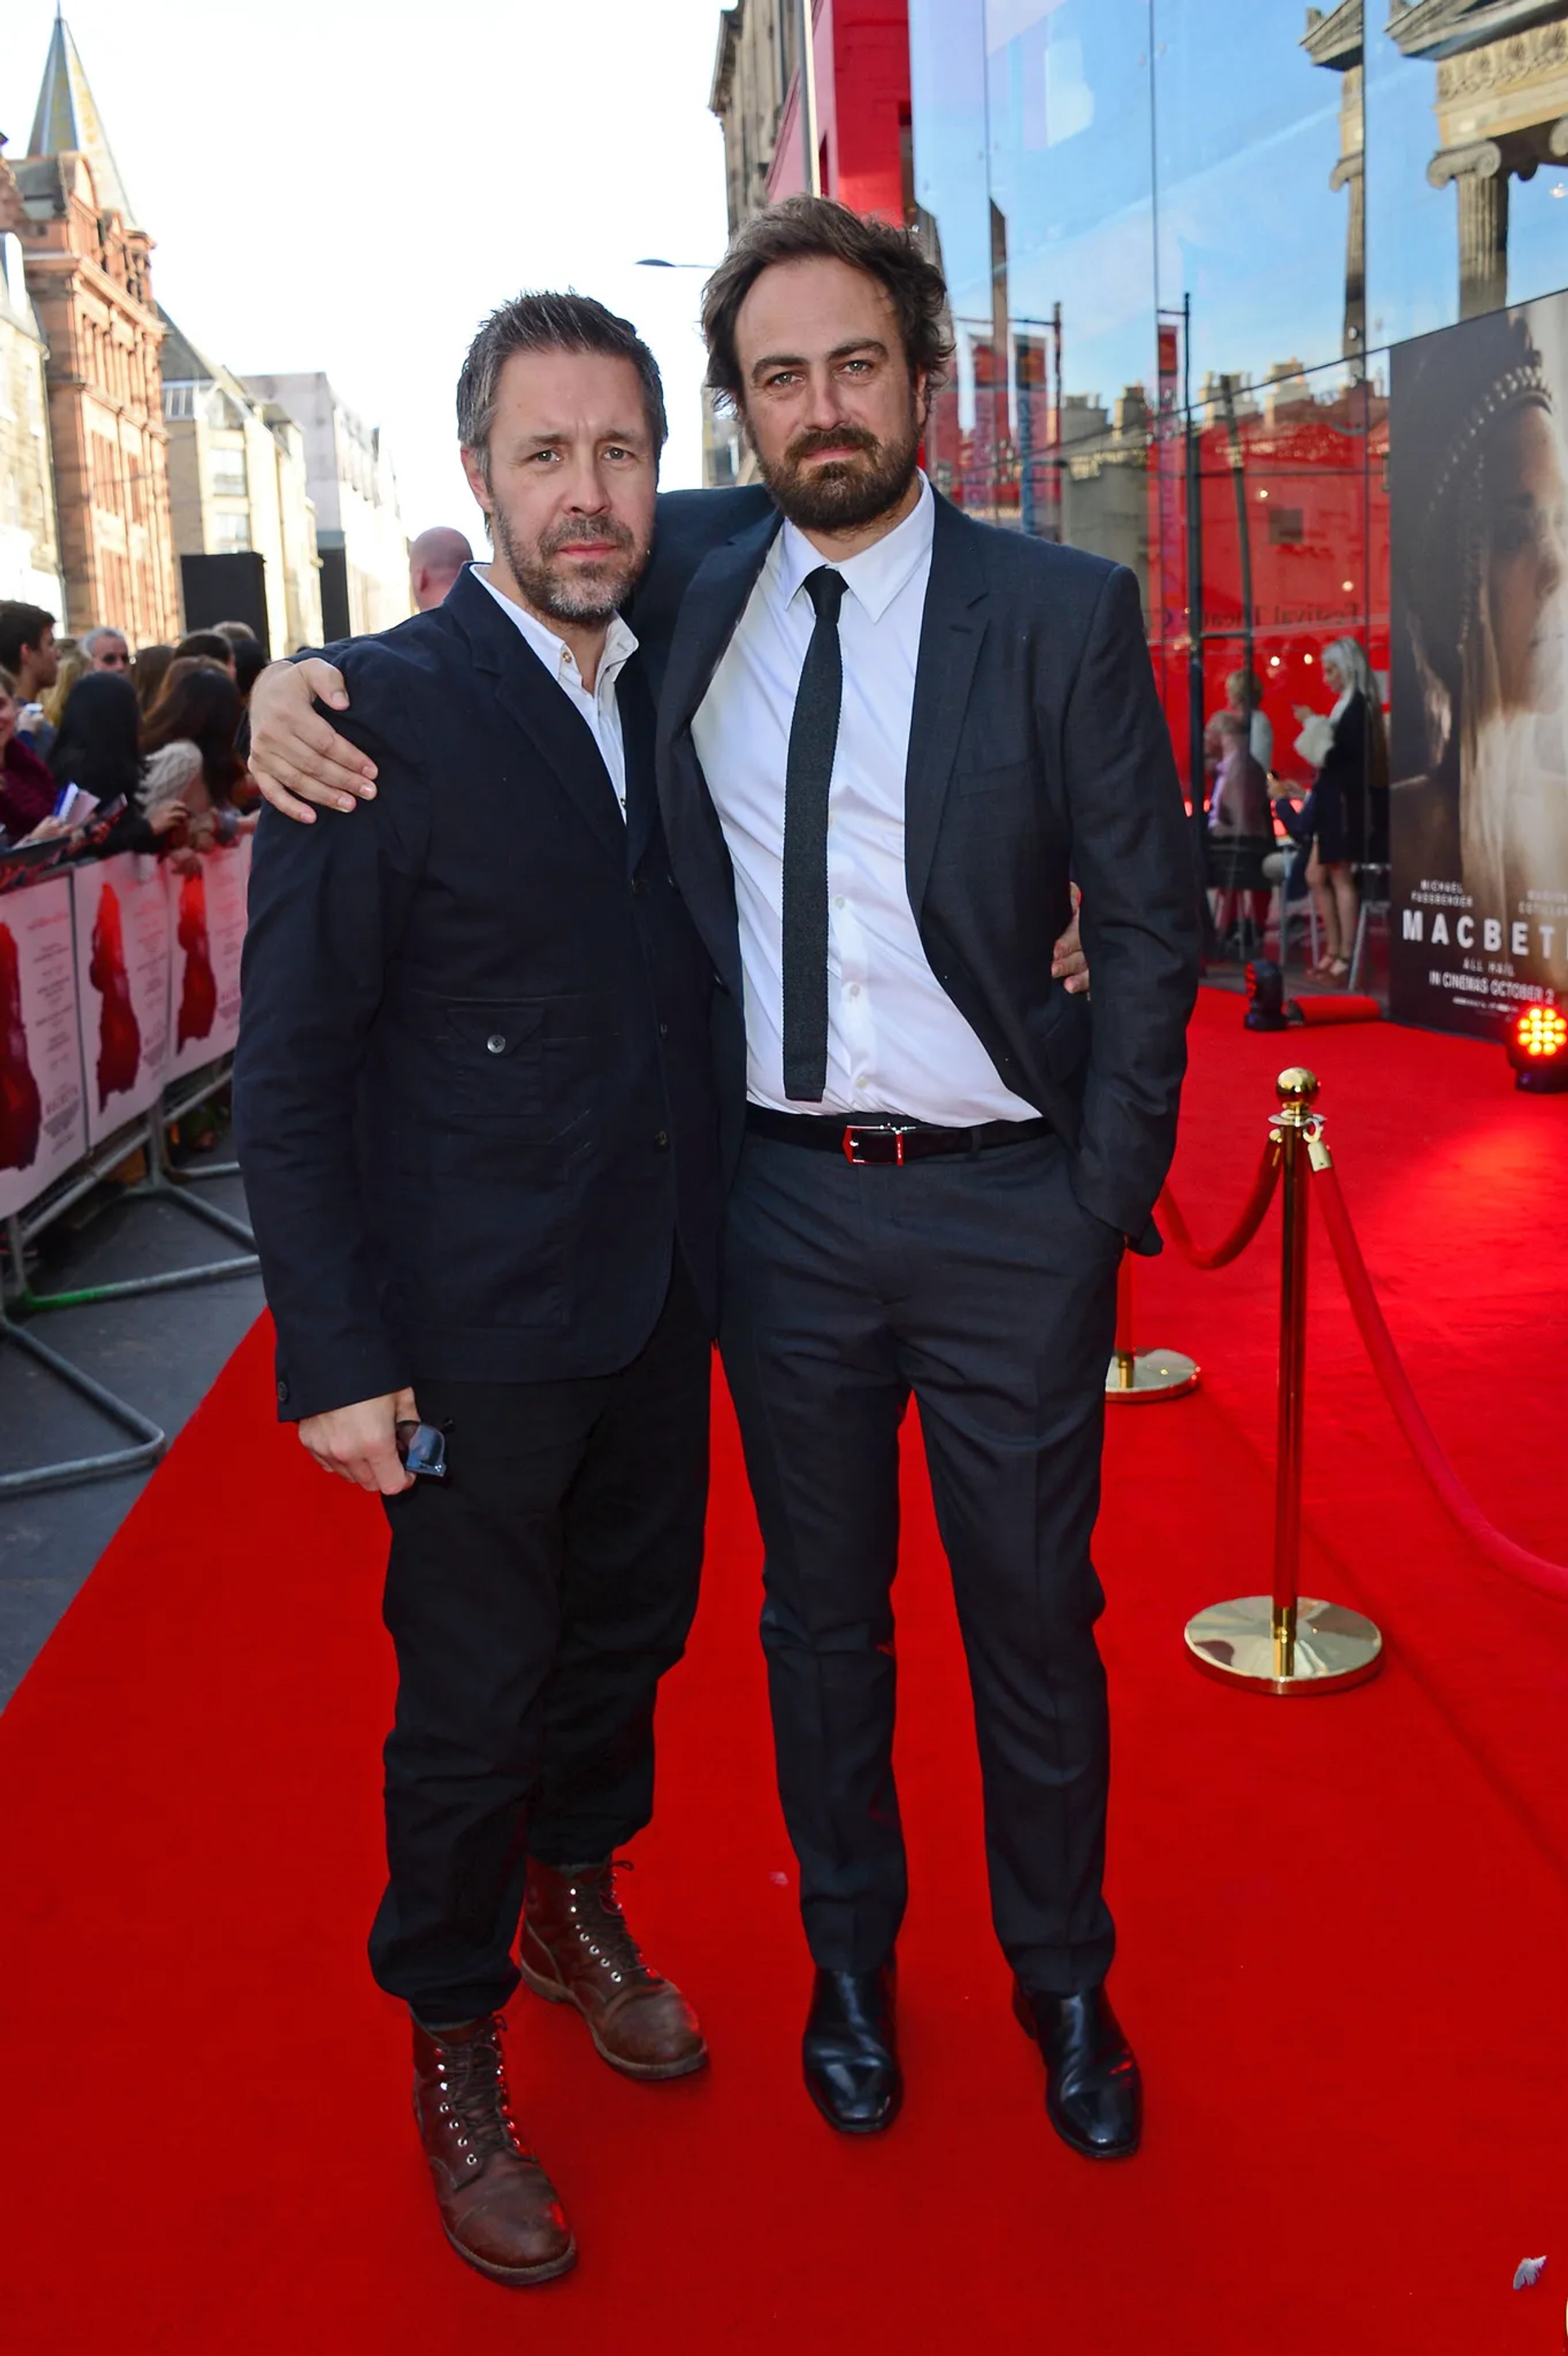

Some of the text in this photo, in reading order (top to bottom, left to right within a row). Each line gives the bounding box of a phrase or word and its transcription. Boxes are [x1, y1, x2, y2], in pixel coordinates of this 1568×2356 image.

[1402, 909, 1568, 960] MACBET
[1463, 956, 1515, 977] ALL HAIL
[1429, 971, 1555, 1004] IN CINEMAS OCTOBER 2
